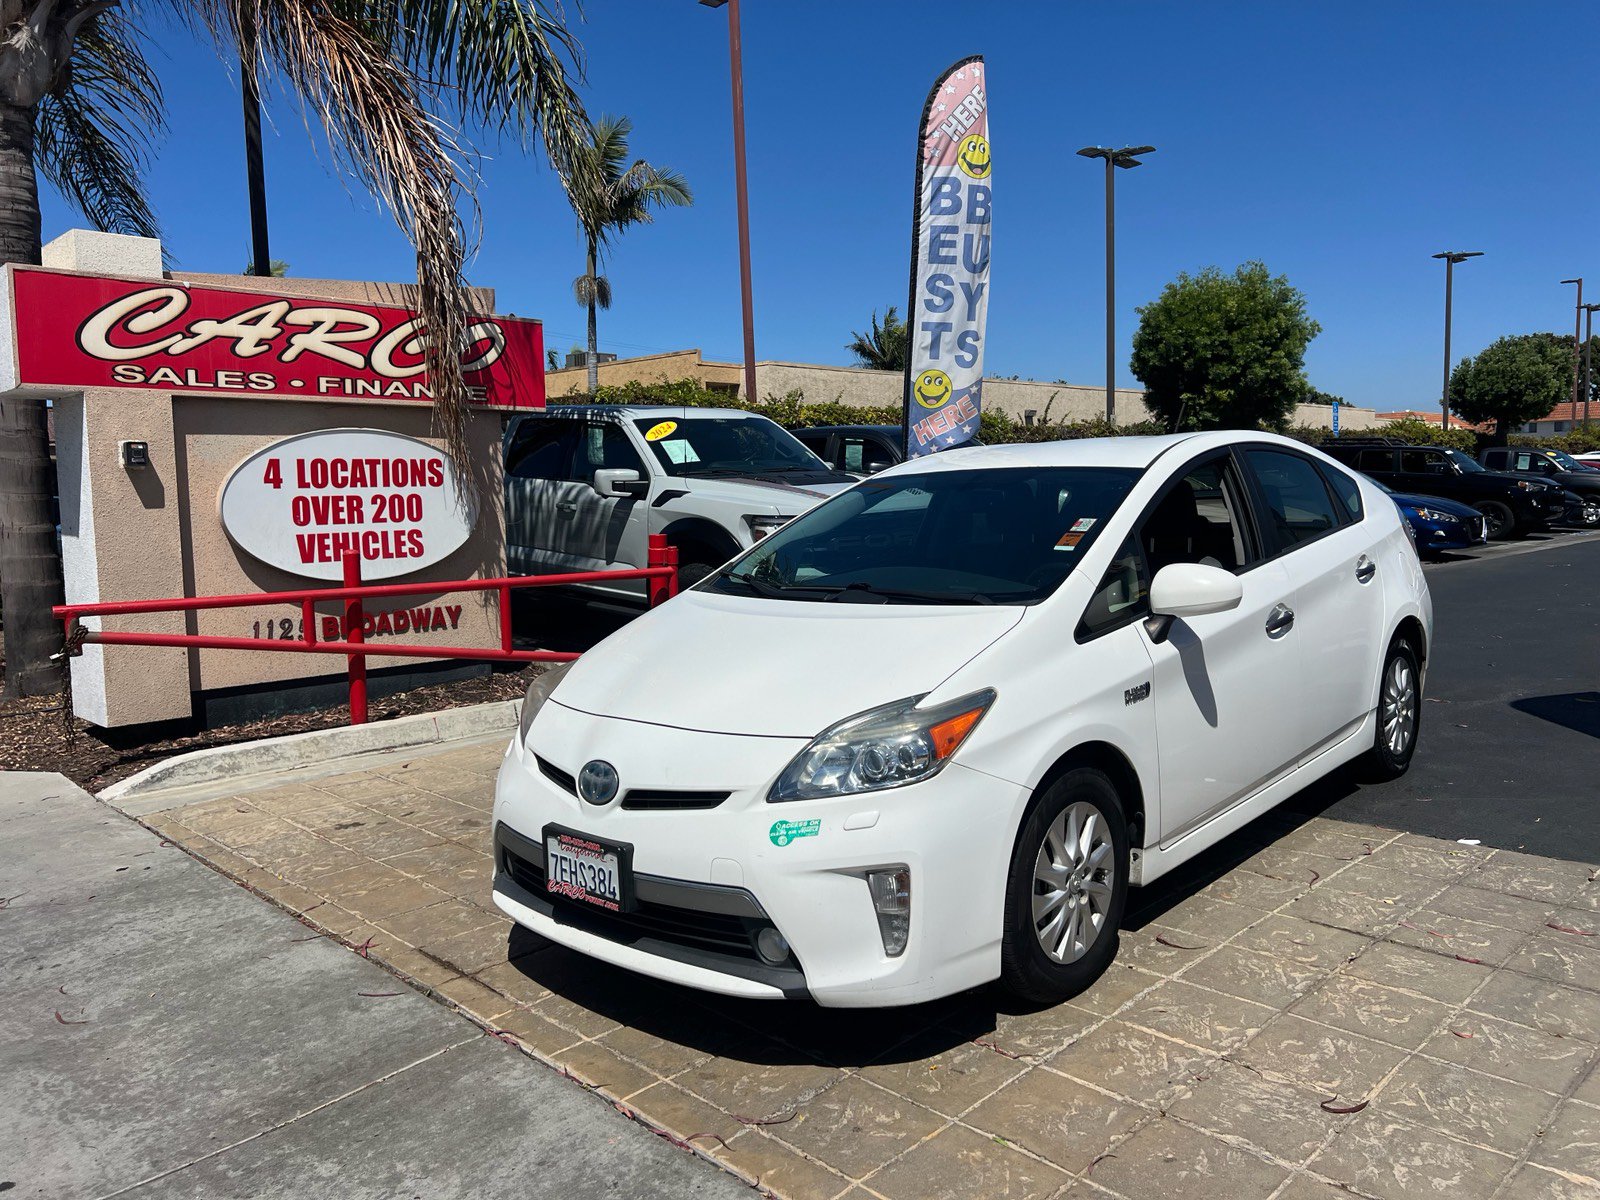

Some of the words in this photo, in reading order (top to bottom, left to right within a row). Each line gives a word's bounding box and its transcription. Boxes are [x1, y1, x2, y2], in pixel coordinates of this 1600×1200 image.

[940, 84, 987, 143] HERE
[112, 364, 277, 391] SALES
[317, 375, 488, 402] FINANE
[650, 423, 672, 439] 2024
[912, 394, 978, 446] HERE
[263, 458, 283, 489] 4
[296, 458, 444, 489] LOCATIONS
[291, 494, 364, 527] OVER
[371, 493, 423, 523] 200
[296, 528, 425, 564] VEHICLES
[322, 604, 463, 642] BOADWAY
[550, 852, 617, 900] 7EHS384
